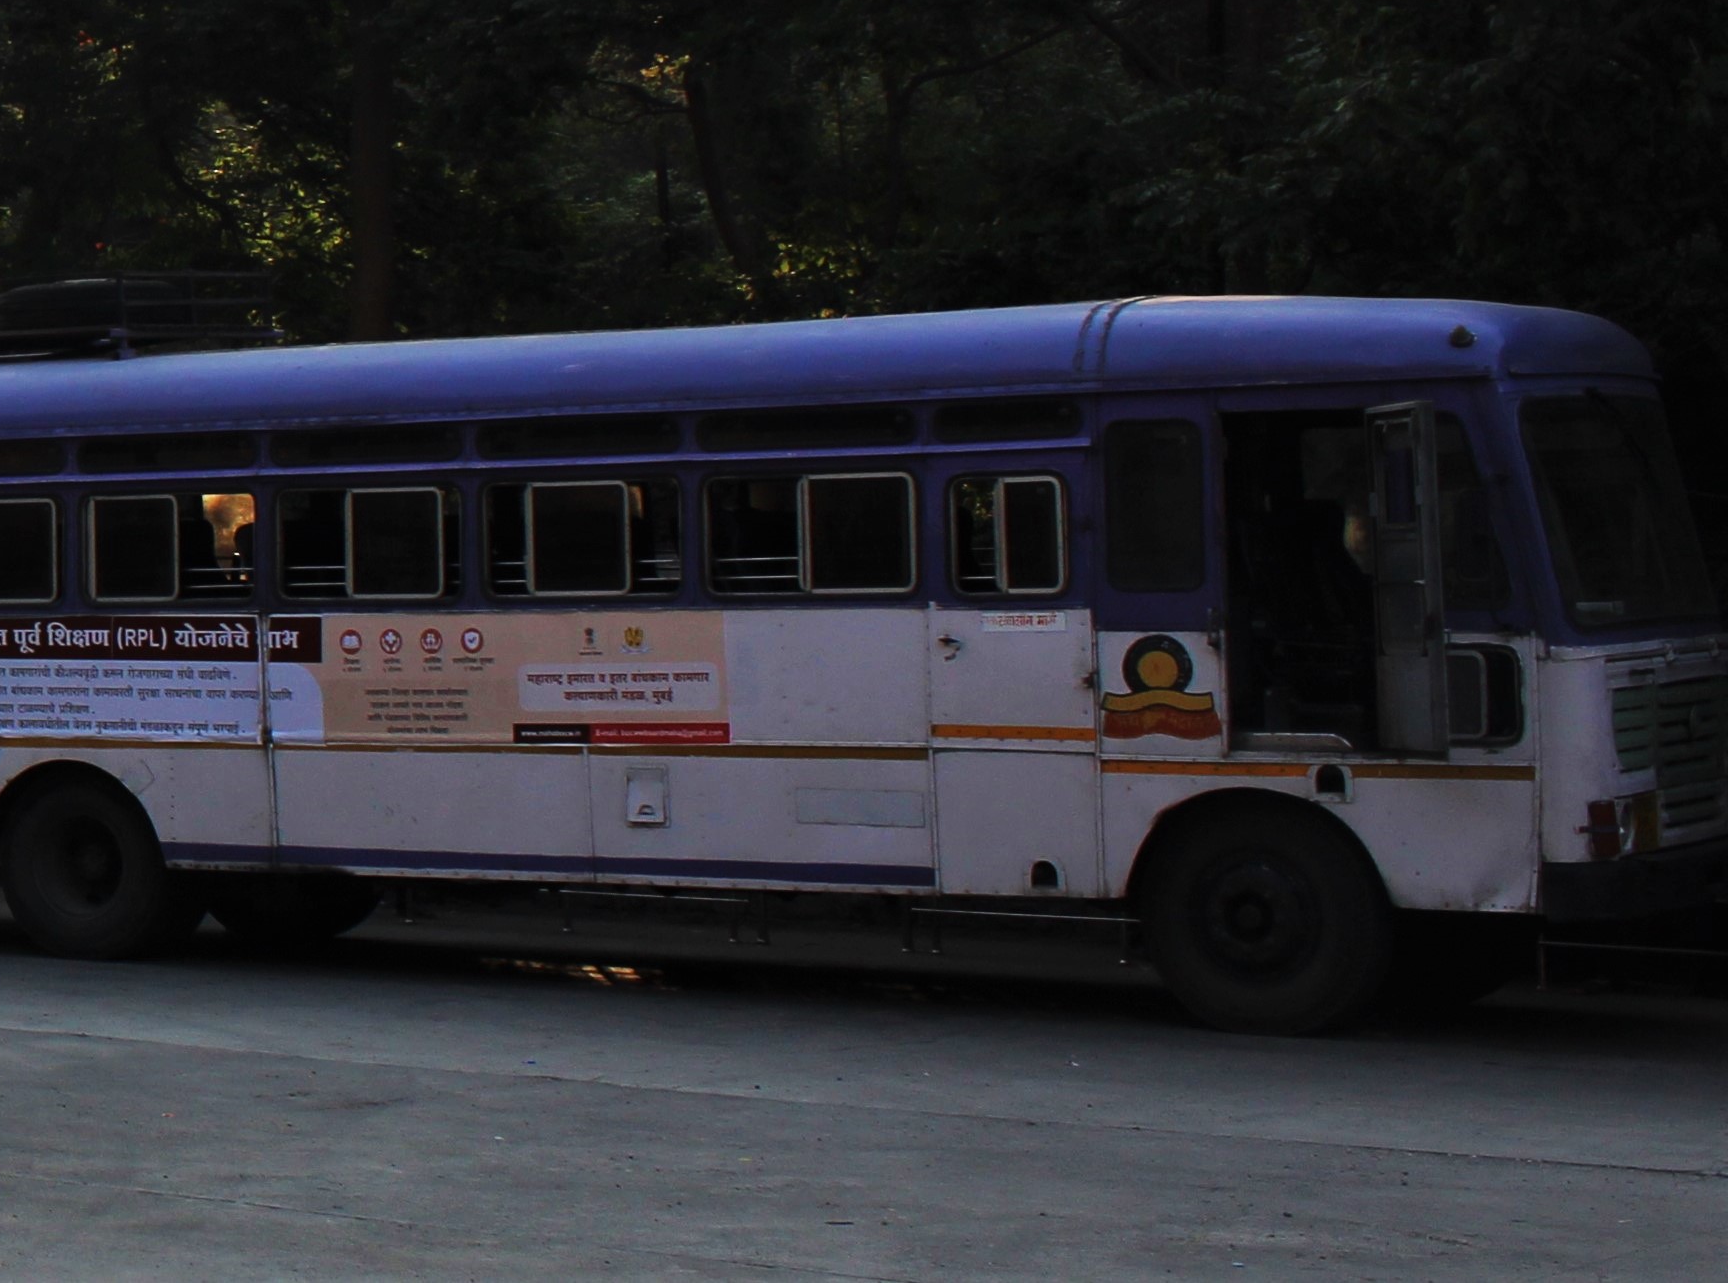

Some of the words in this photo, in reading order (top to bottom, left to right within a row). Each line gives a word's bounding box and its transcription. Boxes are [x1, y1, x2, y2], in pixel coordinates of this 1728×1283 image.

[12, 621, 42, 654] पूर्व
[46, 622, 111, 648] शिक्षण
[117, 626, 168, 651] (RPL)
[173, 622, 250, 649] योजनेचे
[257, 629, 300, 649] ाभ
[566, 673, 595, 685] इमारत
[598, 674, 606, 683] व
[609, 673, 627, 685] इतर
[672, 672, 709, 683] कामगार
